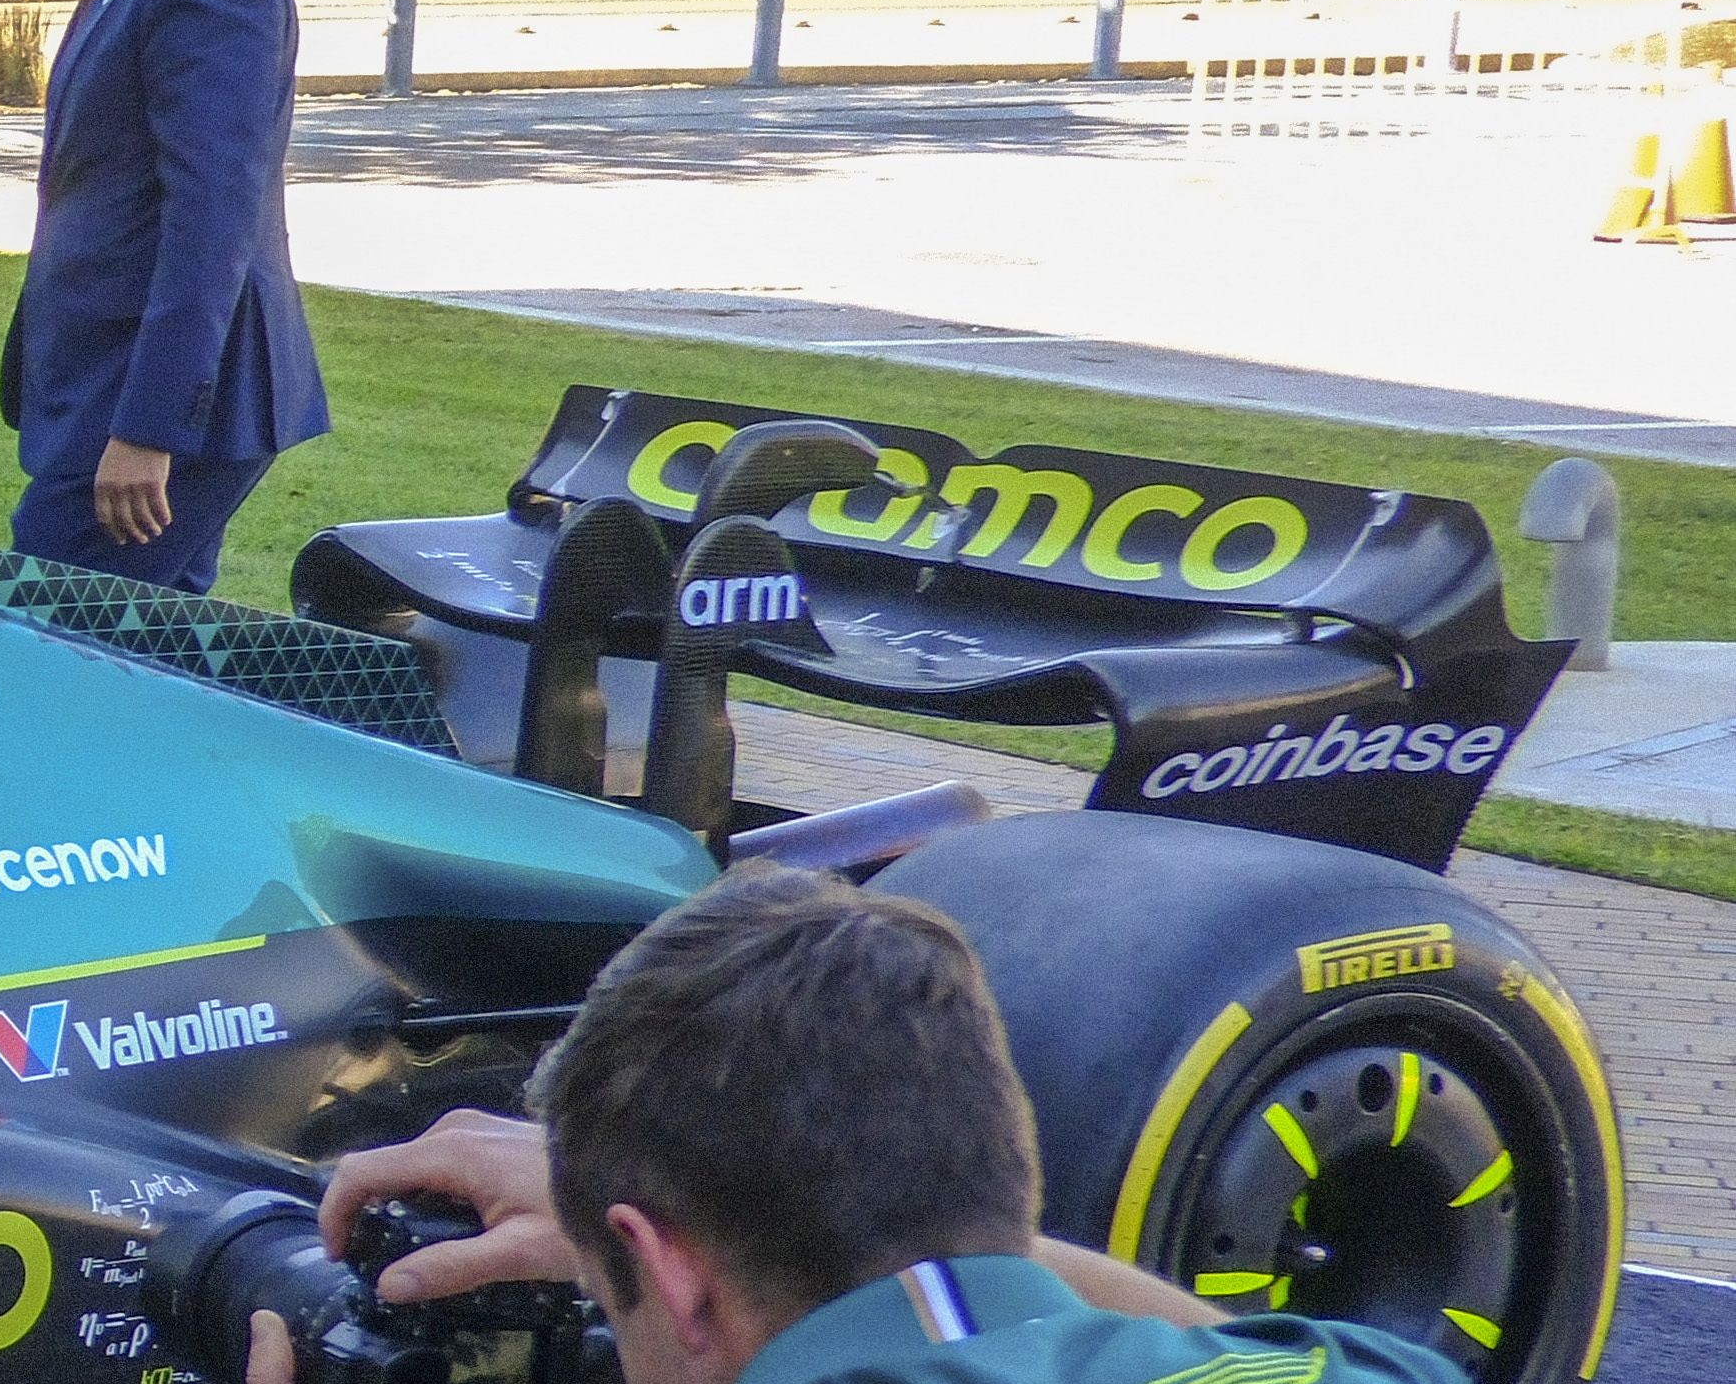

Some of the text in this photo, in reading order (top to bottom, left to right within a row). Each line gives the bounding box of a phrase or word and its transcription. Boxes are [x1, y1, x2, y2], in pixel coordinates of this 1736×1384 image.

[678, 573, 802, 628] arm
[1139, 712, 1512, 801] coinbase
[1297, 923, 1457, 995] PIRELLI
[71, 999, 277, 1071] Valvoline
